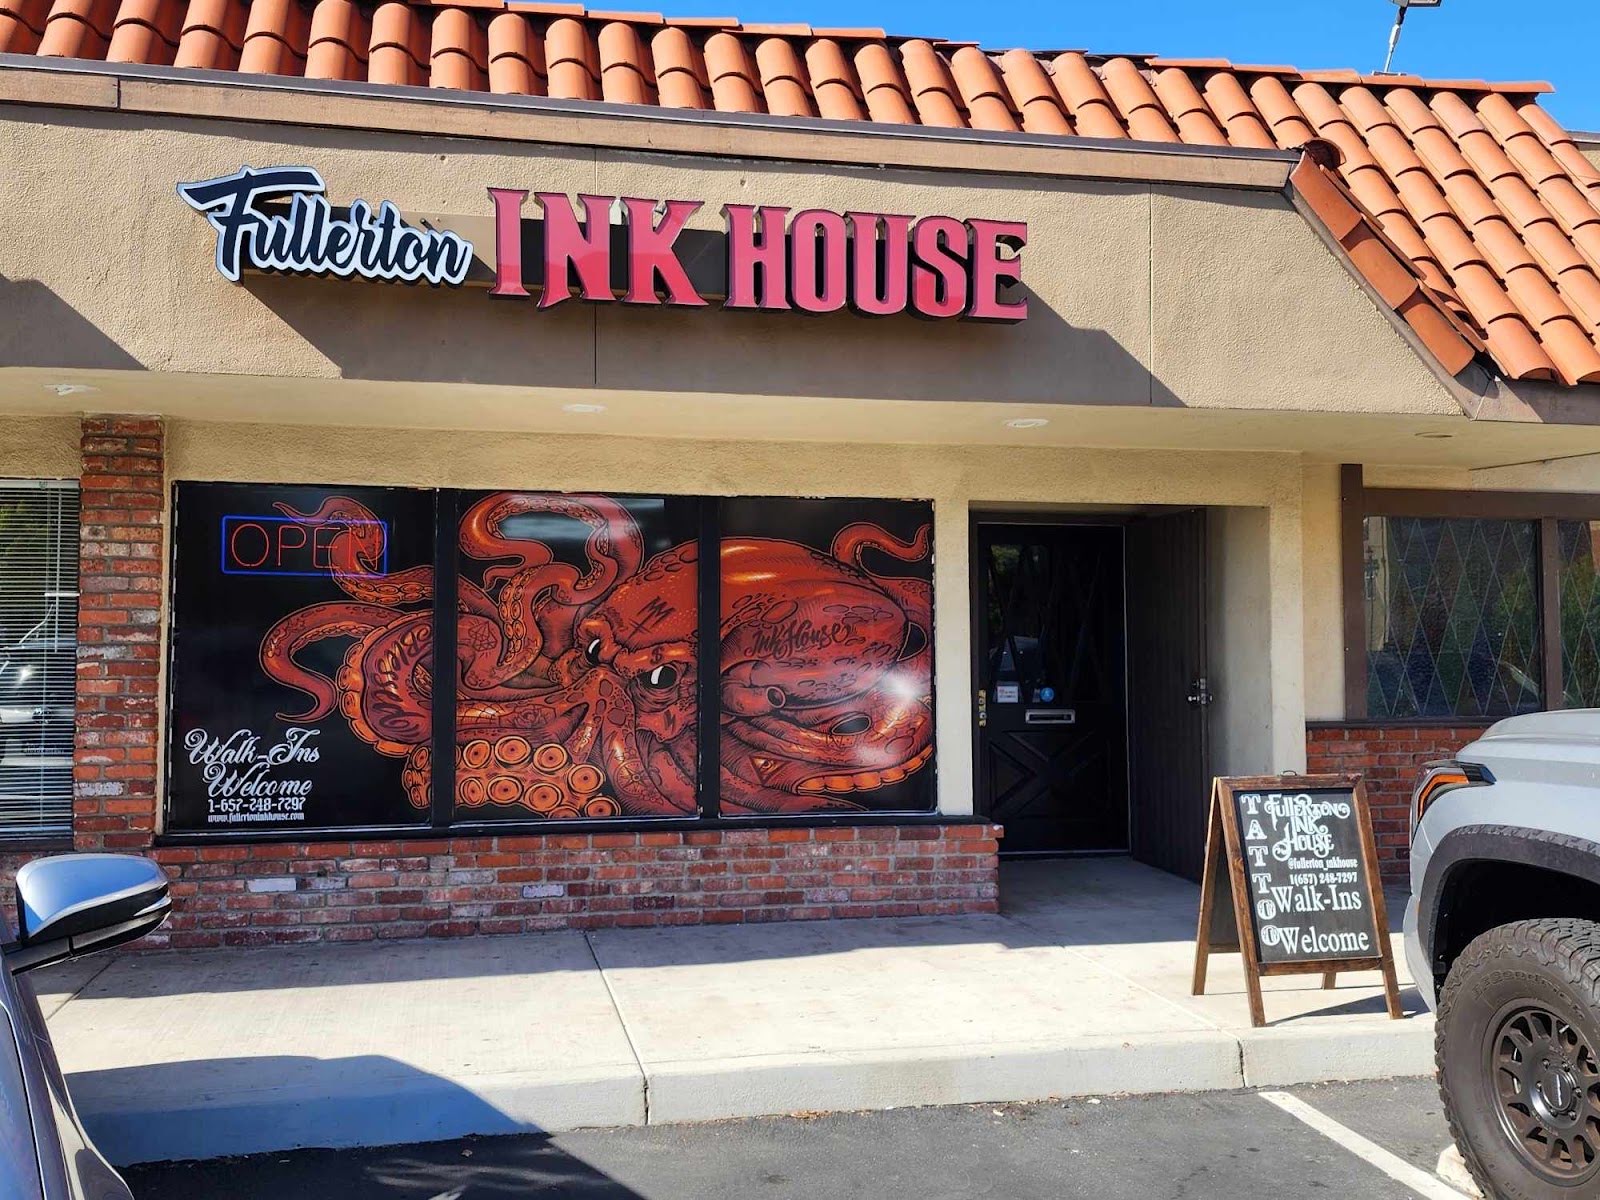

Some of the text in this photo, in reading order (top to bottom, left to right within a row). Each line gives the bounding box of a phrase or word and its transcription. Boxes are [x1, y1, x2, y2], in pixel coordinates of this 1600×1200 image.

[176, 165, 1028, 321] Fullerton INK HOUSE
[184, 728, 321, 765] Walk-Ins
[202, 761, 313, 798] Welcome
[207, 796, 307, 813] 1-657-248-7297
[1240, 793, 1281, 947] TATTOO
[1289, 871, 1358, 887] 1(657) 248-7297
[1271, 884, 1362, 913] Walk-Ins
[1278, 925, 1370, 955] Welcome
